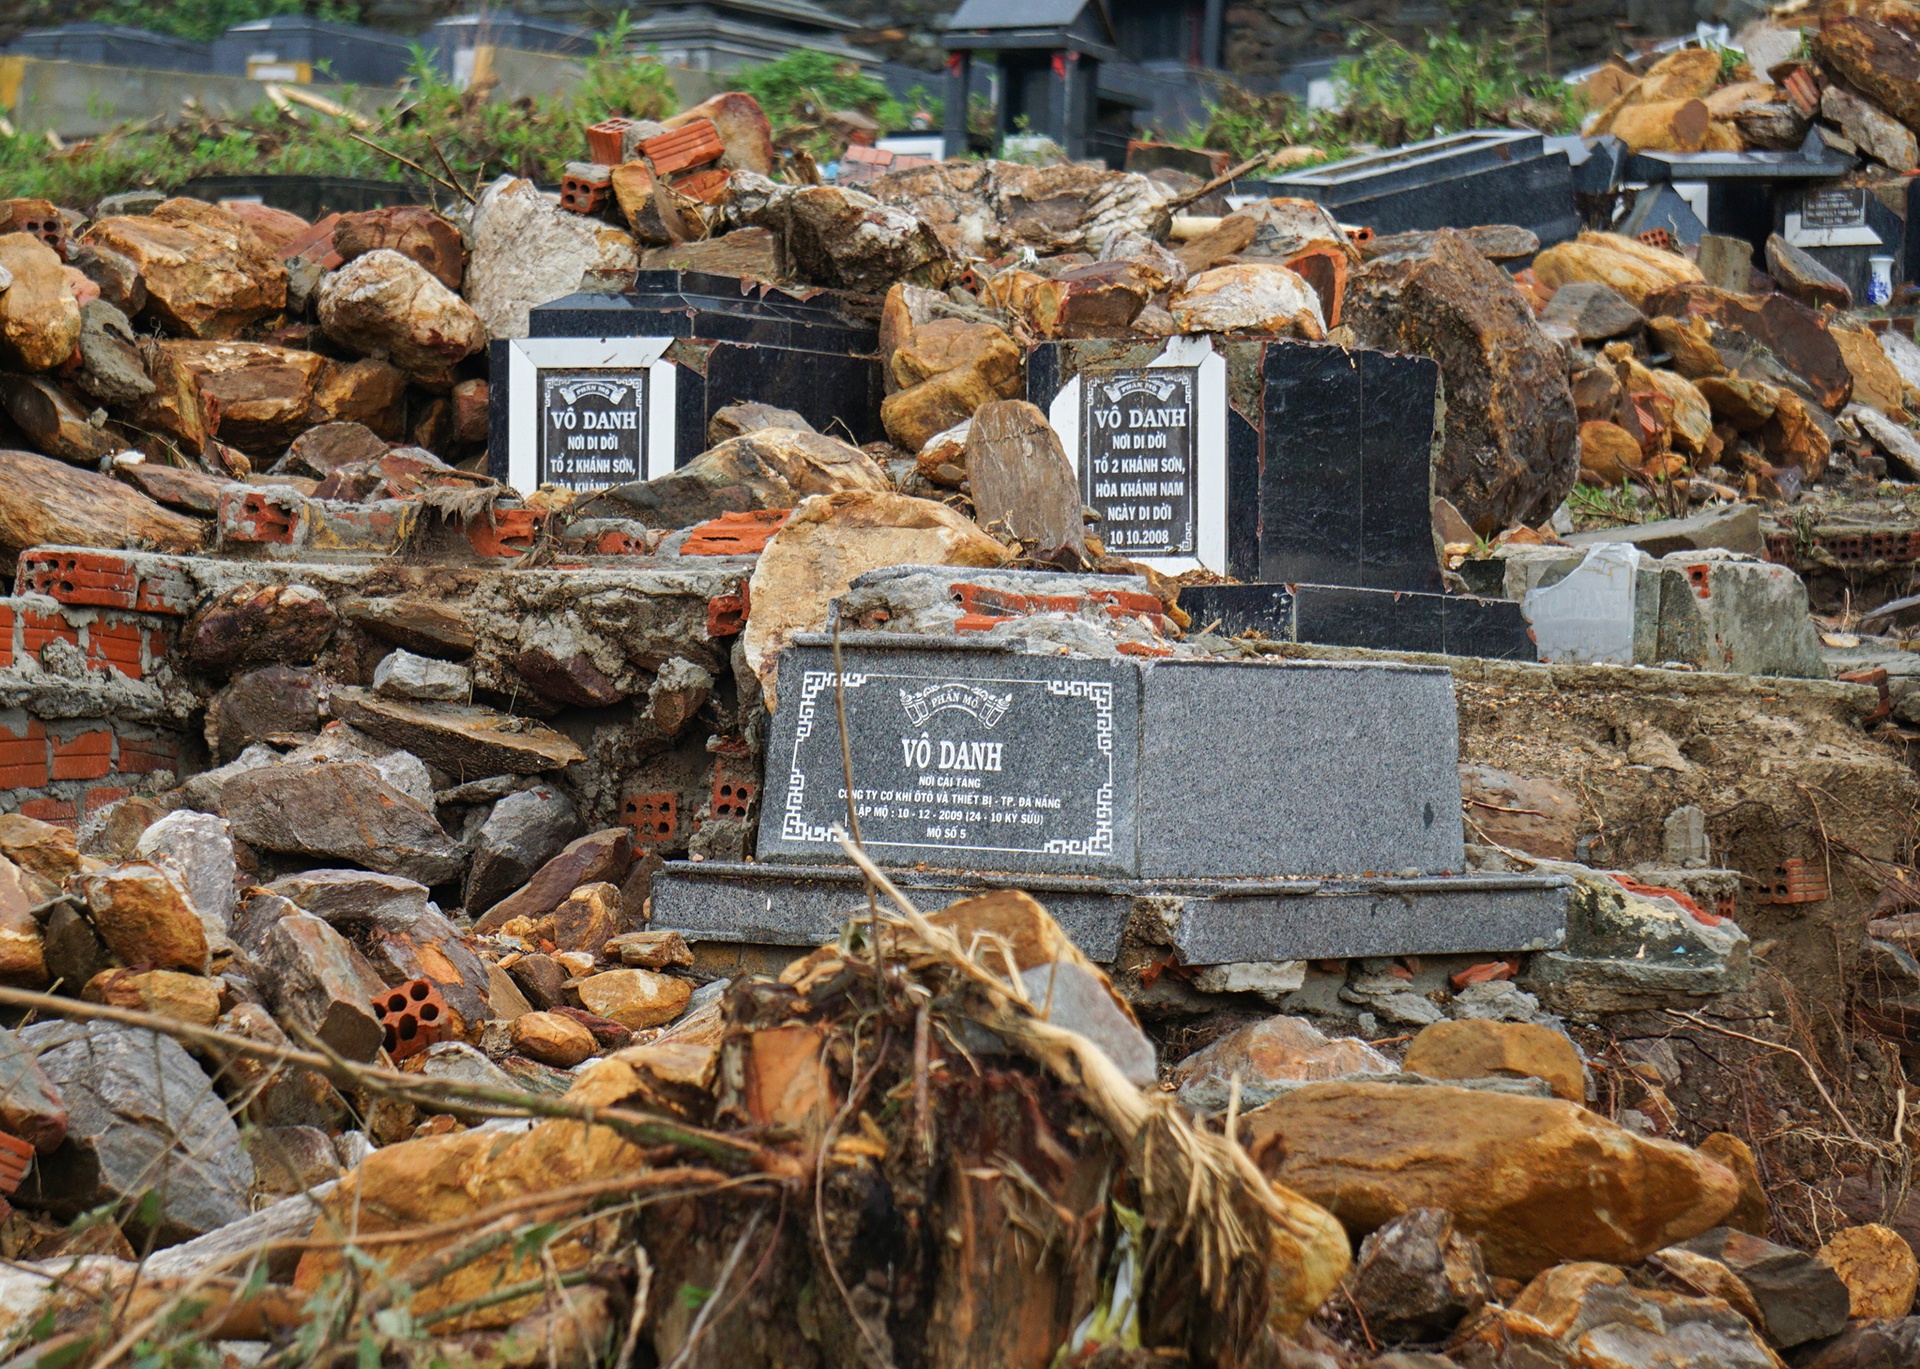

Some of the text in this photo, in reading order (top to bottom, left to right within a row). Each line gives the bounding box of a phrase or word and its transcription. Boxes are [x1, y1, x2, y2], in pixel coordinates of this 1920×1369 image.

[550, 406, 637, 430] VÔ DANH
[1094, 404, 1187, 429] VÔ DANH
[567, 433, 618, 450] NƠI DI DỜI
[1112, 430, 1167, 450] NƠI DI DỜI
[550, 453, 636, 476] TỔ 2 KHÁNH SƠN,
[1094, 452, 1186, 475] TỔ 2 KHÁNH SƠN,
[1095, 479, 1184, 498] HÒA KHÁNH NAM
[1107, 503, 1172, 521] NGÀY DI DỜI
[901, 731, 1004, 771] VÔ DANH
[919, 775, 935, 787] NƠI
[866, 789, 878, 801] TY
[880, 790, 894, 801] CƠ
[895, 790, 912, 802] KHÍ
[914, 790, 934, 803] ÔTÔ
[936, 791, 949, 804] VÀ
[951, 790, 980, 805] THIẾT
[1001, 796, 1016, 807] TP.
[873, 804, 889, 819] MỘ
[897, 808, 910, 818] 10
[918, 809, 931, 820] 12
[938, 810, 963, 821] 2009
[990, 812, 1003, 823] 10
[926, 825, 967, 840] MỘ SỐ 5
